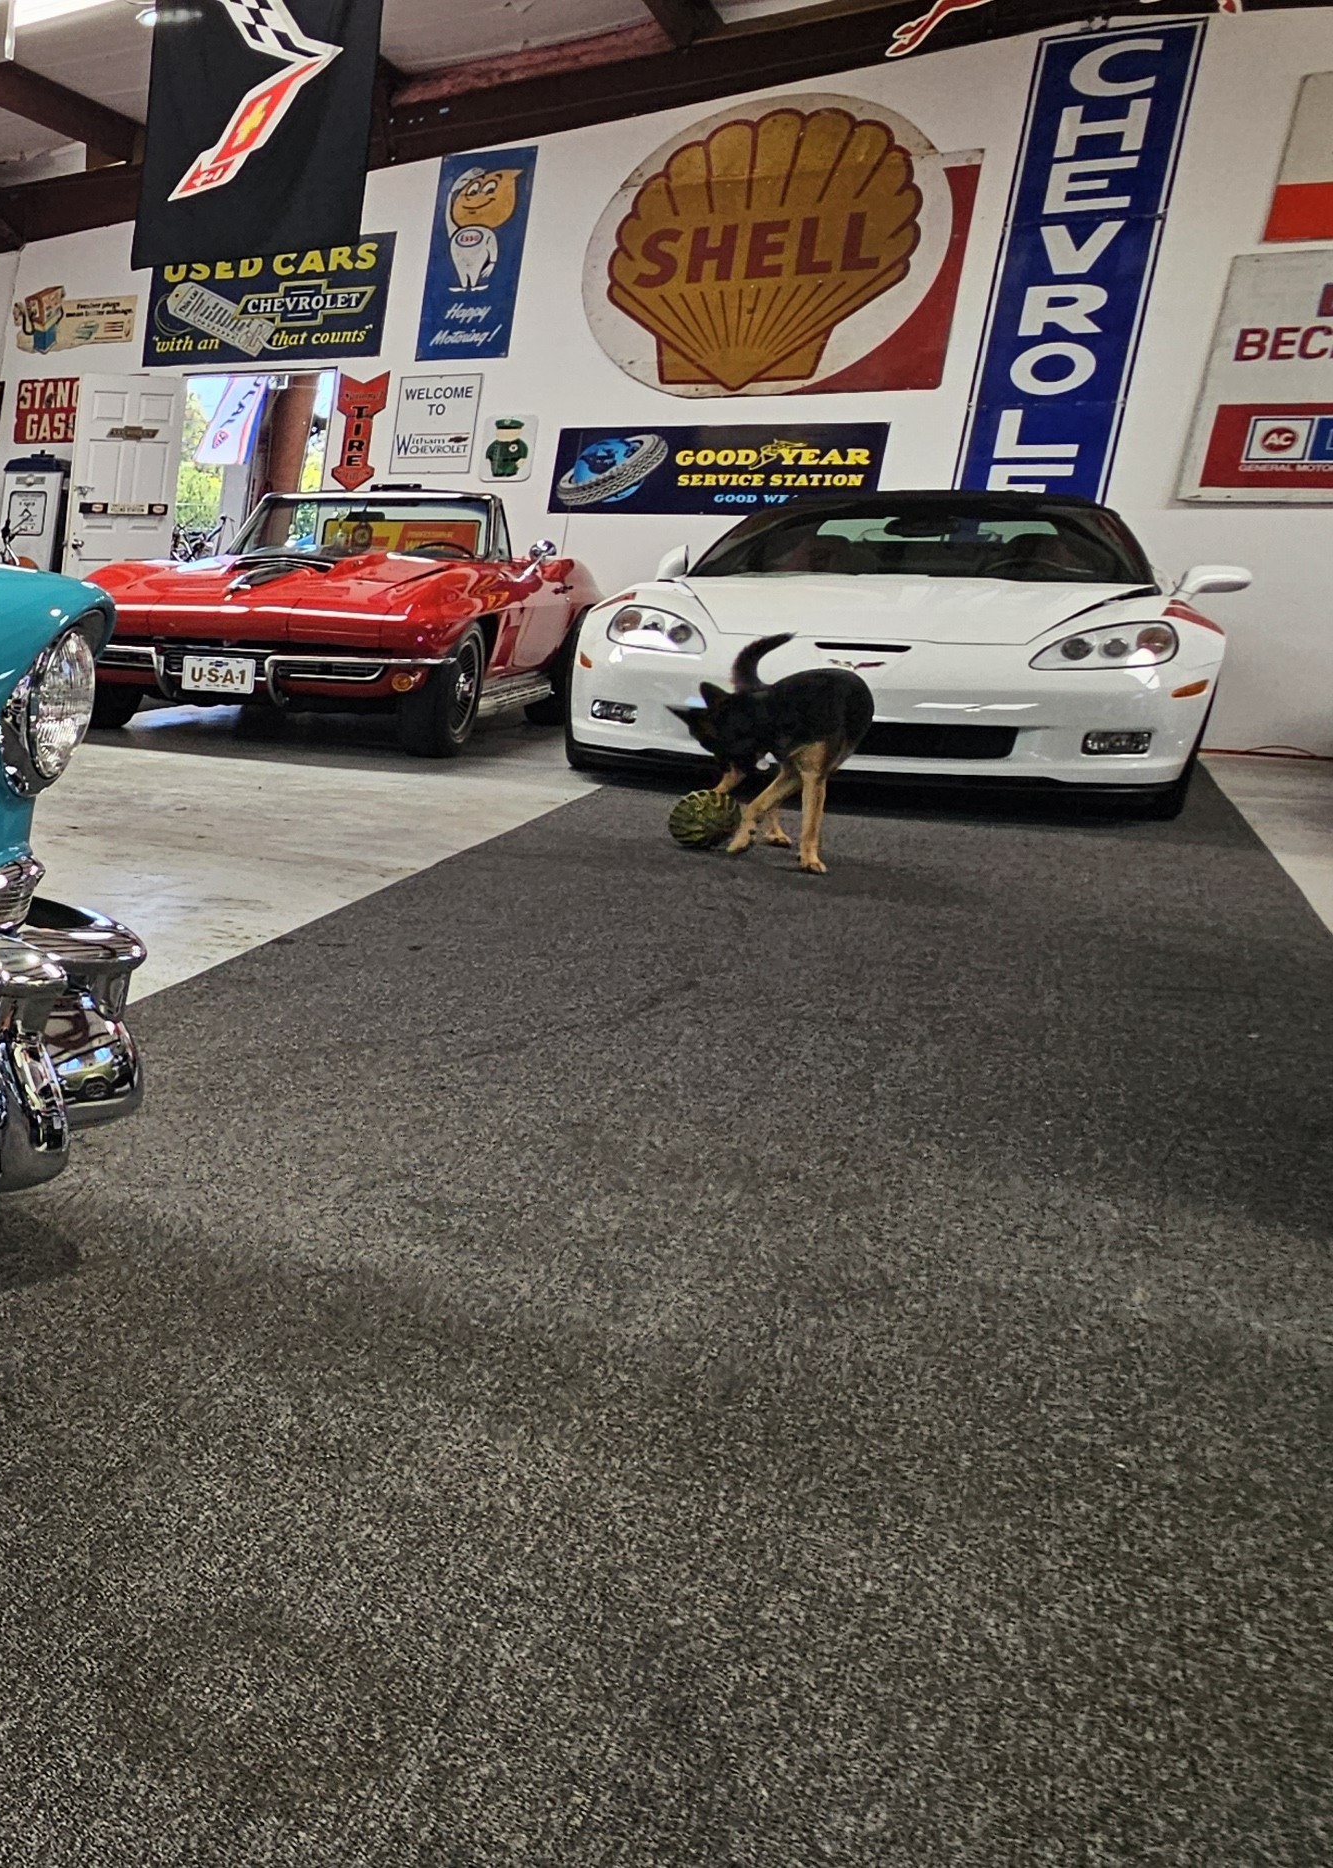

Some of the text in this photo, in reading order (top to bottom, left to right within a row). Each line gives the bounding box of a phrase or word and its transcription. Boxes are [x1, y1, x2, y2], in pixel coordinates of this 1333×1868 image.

[633, 211, 881, 289] SHELL
[163, 242, 378, 282] USED CARS
[247, 292, 361, 314] CHEVROLET
[445, 302, 491, 323] Happy
[271, 330, 306, 347] that
[430, 323, 503, 347] Motoring!
[1234, 325, 1333, 361] BEC
[197, 338, 220, 351] an
[405, 386, 474, 401] WELCOME
[427, 403, 446, 416] TO
[346, 405, 370, 467] TIRE
[396, 432, 445, 456] Witham
[1264, 432, 1294, 446] AC
[409, 444, 468, 455] CHEVROLET
[1238, 464, 1293, 472] GENERAL
[677, 473, 865, 487] SERVICE STATION
[714, 493, 799, 504] GOOD WE
